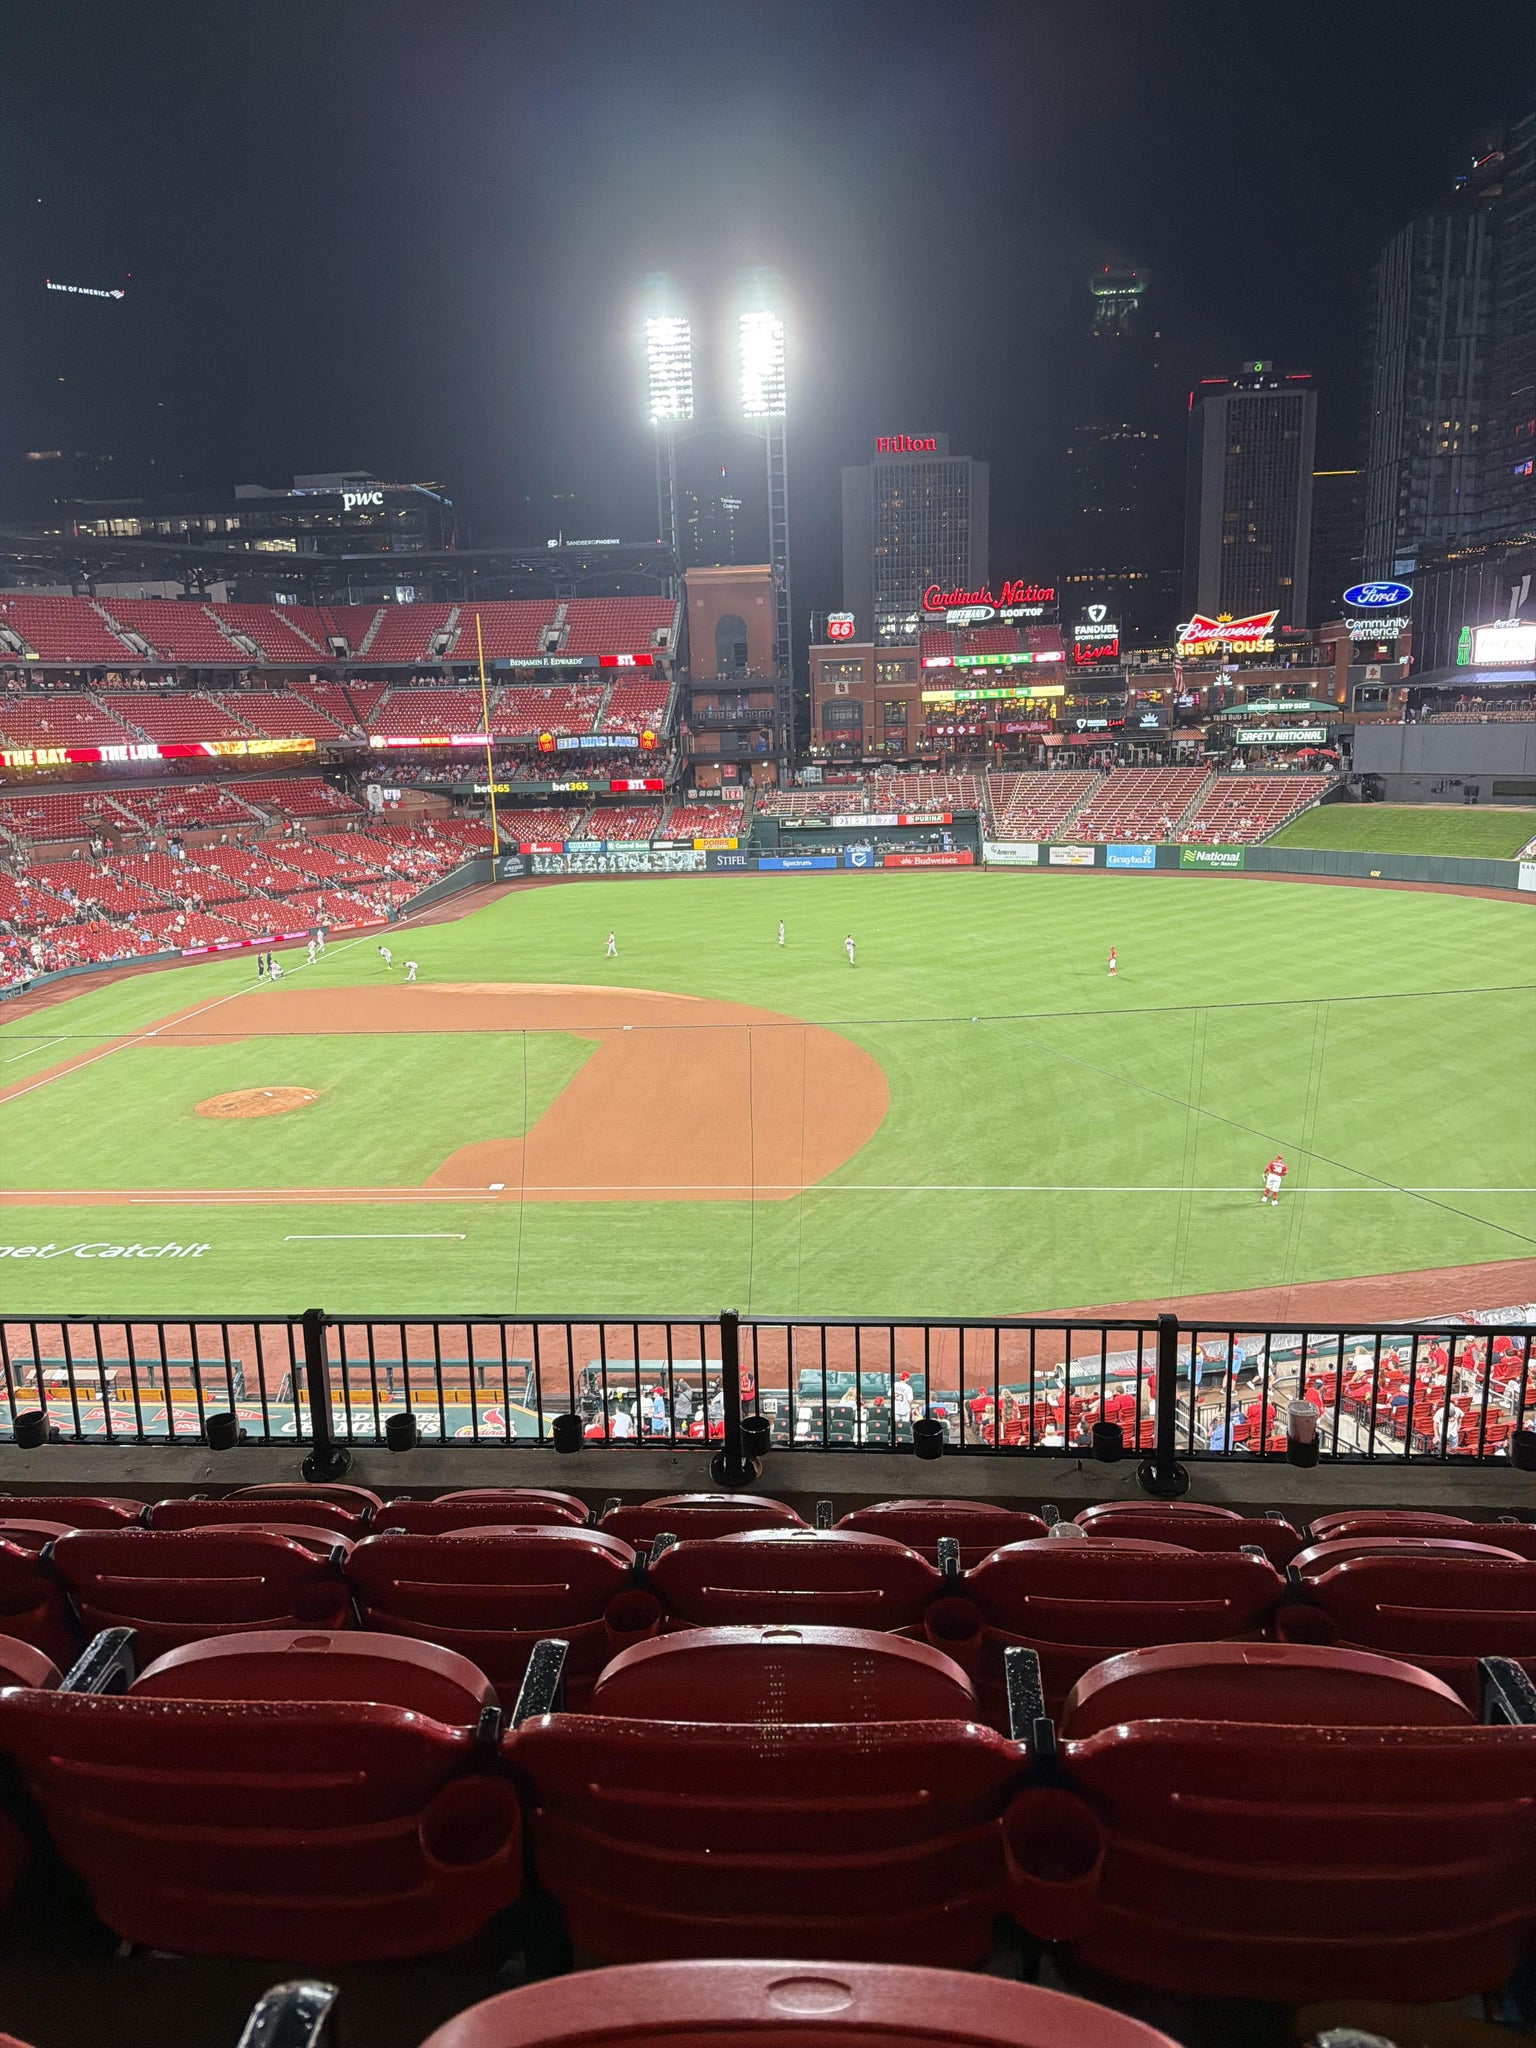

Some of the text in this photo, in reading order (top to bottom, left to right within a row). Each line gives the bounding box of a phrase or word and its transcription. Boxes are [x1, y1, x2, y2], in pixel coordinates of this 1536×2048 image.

[47, 283, 67, 291] BANK
[78, 287, 110, 297] AMERICA
[877, 434, 936, 452] Hilton
[343, 491, 383, 510] pwc
[923, 580, 1055, 611] Cardinals Nation
[1358, 585, 1399, 603] Ford
[946, 608, 1043, 619] HOFFMANN ROOFTOP
[1345, 617, 1410, 629] Community
[831, 624, 850, 635] 66
[1075, 624, 1119, 634] FANDUEL
[1176, 623, 1274, 641] Budweiser
[510, 658, 543, 666] BENJAMIN
[551, 657, 583, 665] EDWARDS
[617, 655, 635, 665] STL
[609, 736, 638, 747] LAND
[1241, 731, 1322, 741] SAFETY NATIONAL
[2, 748, 72, 766] THE BAT.
[99, 745, 128, 761] THE
[474, 784, 510, 793] bet365
[552, 782, 589, 792] bet365
[628, 780, 646, 789] STL
[717, 855, 747, 866] STIFEL
[914, 856, 958, 864] Budweiser
[895, 1392, 904, 1402] 23
[92, 1410, 116, 1418] 194
